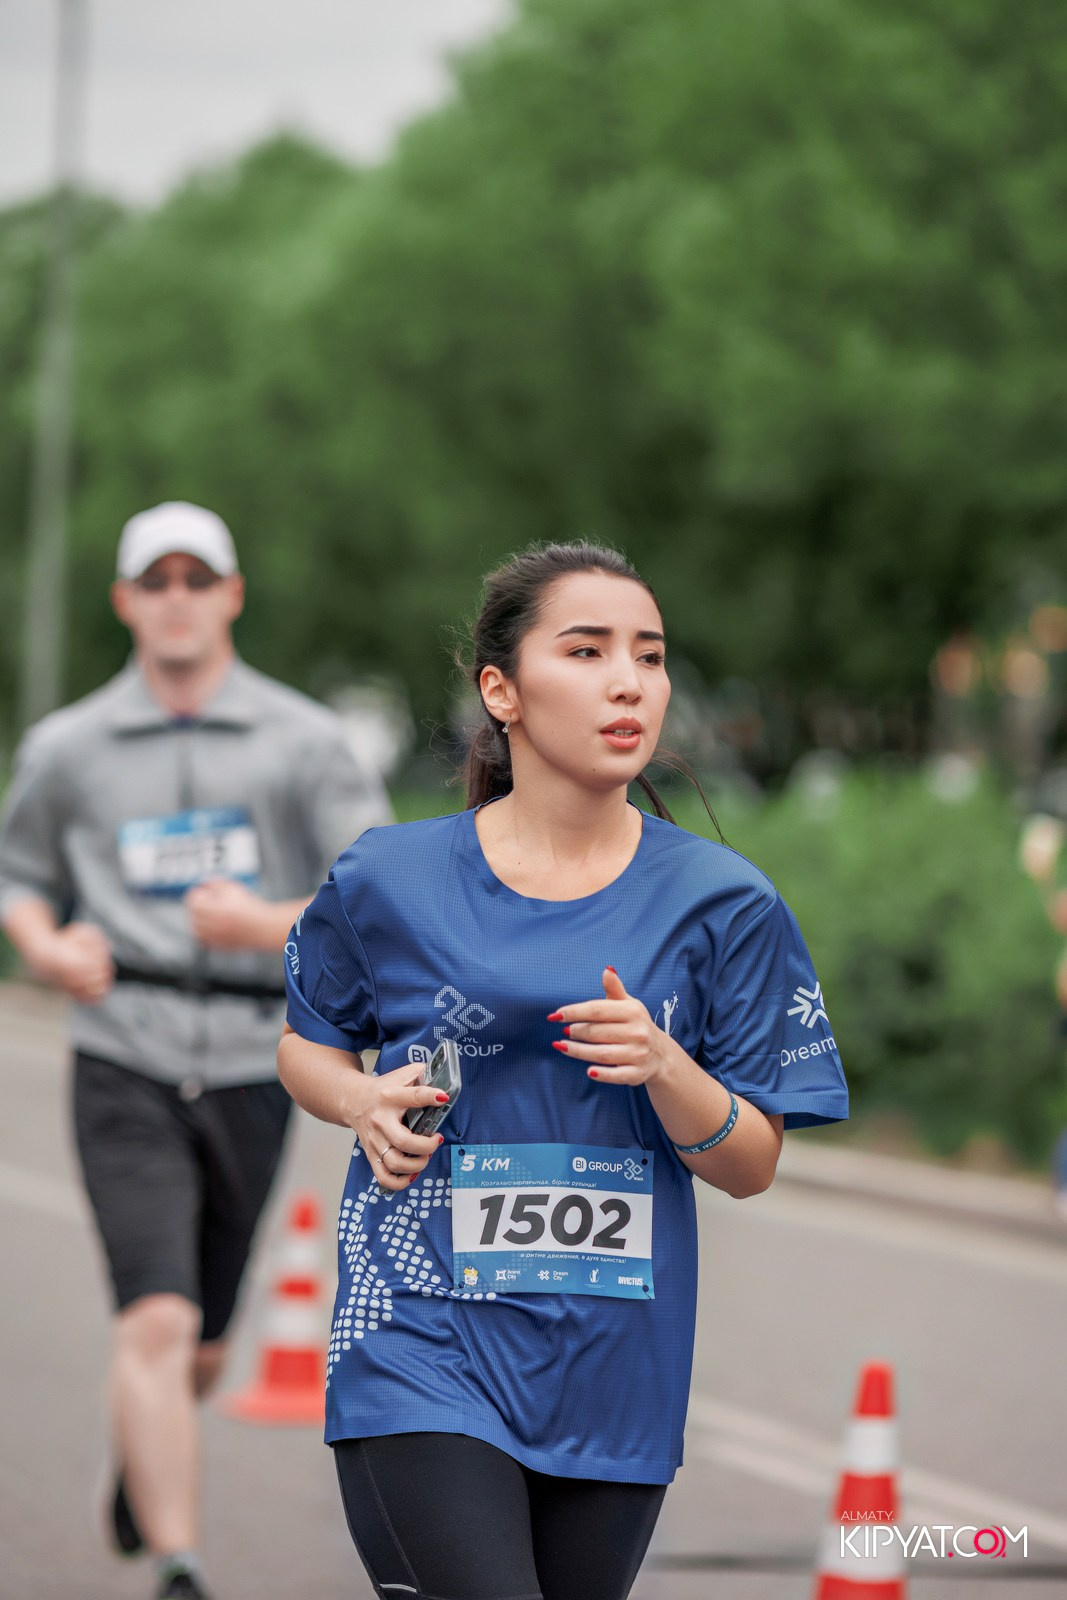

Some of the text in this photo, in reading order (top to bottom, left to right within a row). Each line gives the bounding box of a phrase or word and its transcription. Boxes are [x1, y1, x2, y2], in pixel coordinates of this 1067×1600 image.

[284, 941, 300, 975] City
[411, 1044, 504, 1064] BI ROUP
[780, 1036, 837, 1067] Dream
[460, 1154, 477, 1172] 5
[588, 1161, 623, 1173] GROUP
[479, 1193, 632, 1250] 1502
[618, 1276, 644, 1286] INVICTUS
